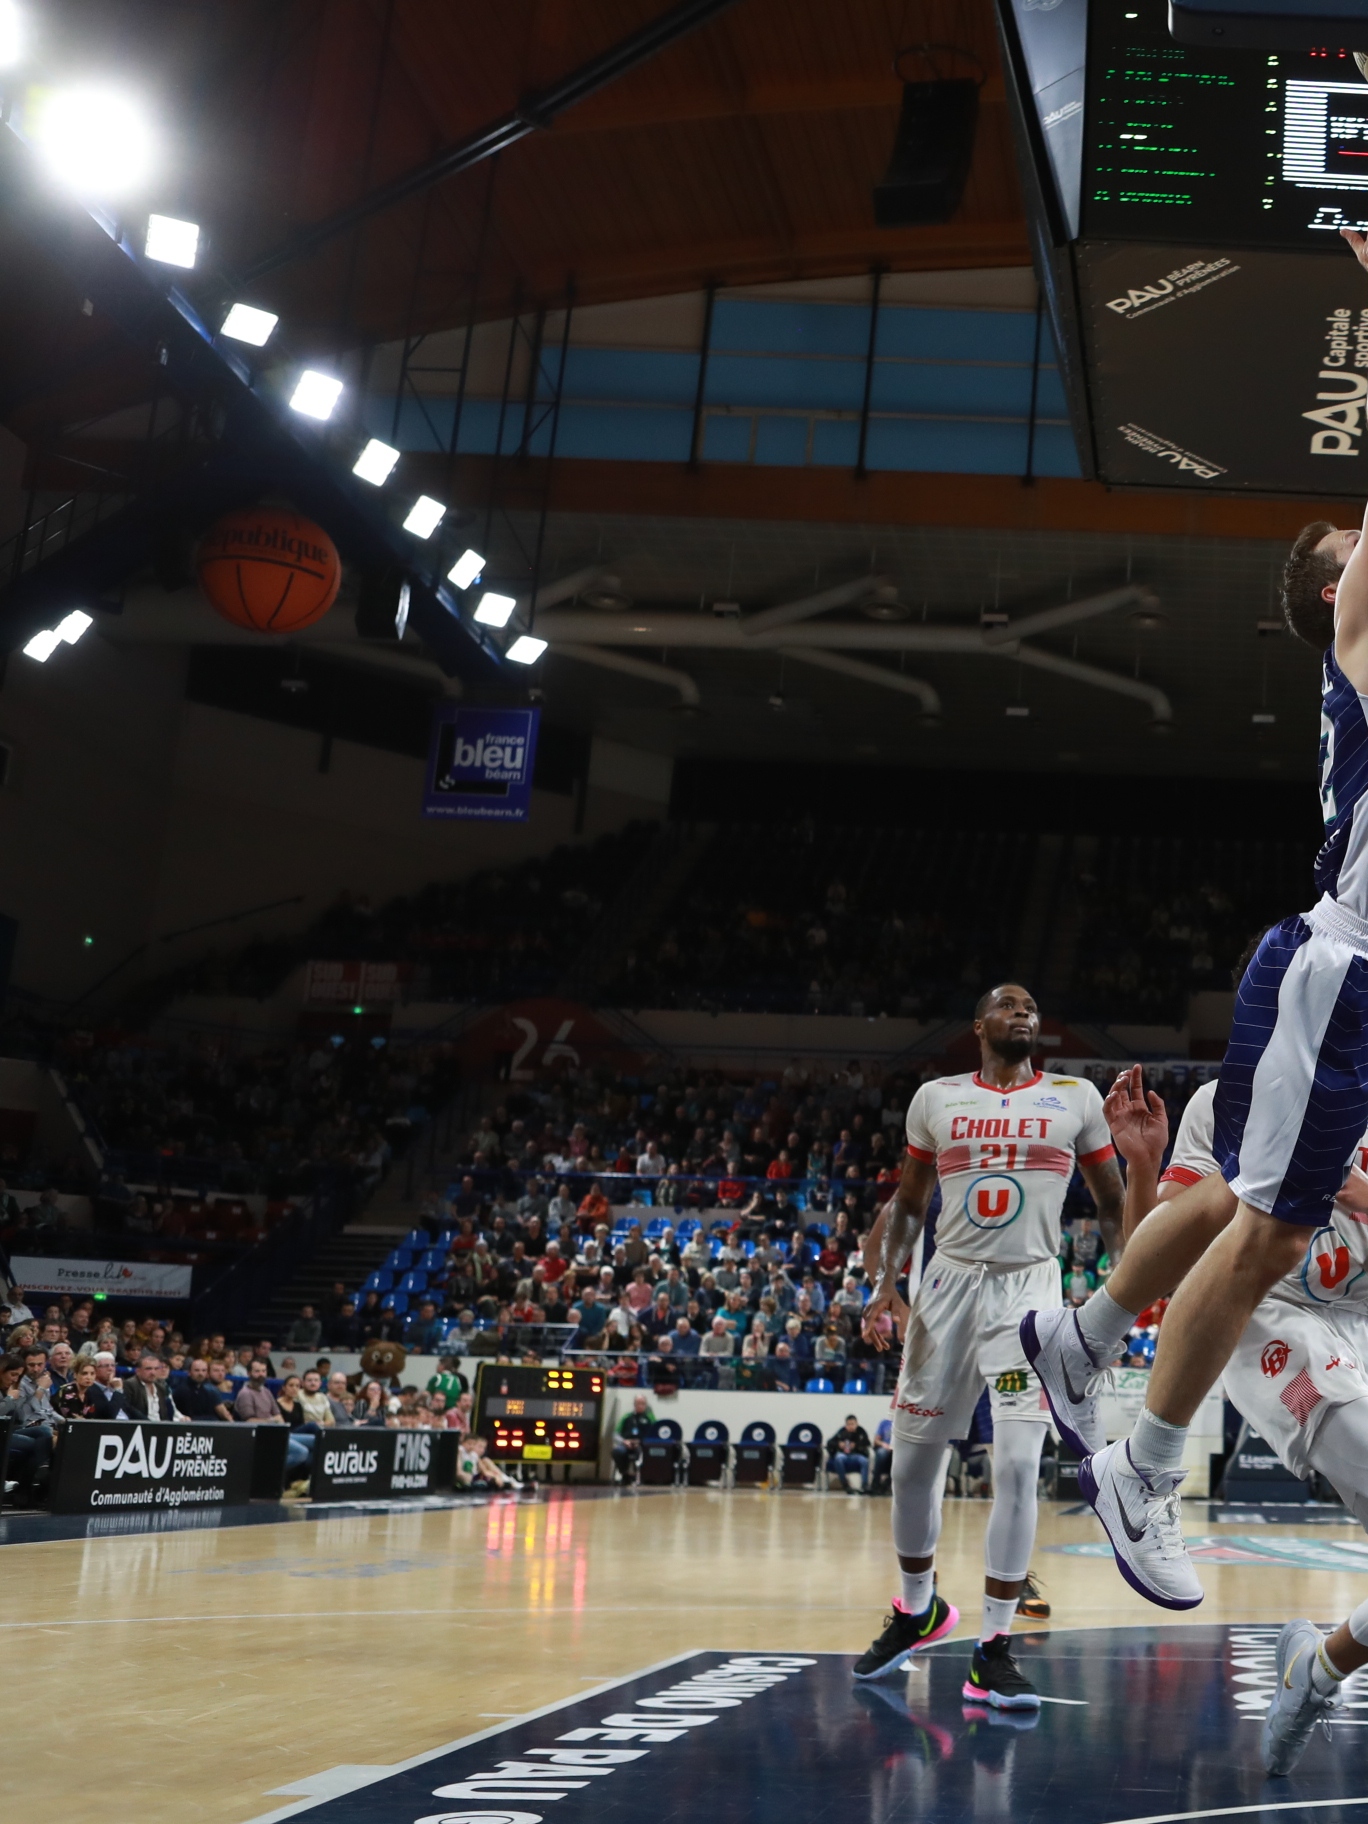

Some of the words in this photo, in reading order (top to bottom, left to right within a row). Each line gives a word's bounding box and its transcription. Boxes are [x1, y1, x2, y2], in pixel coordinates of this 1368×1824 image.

[1105, 279, 1174, 314] PAU
[1322, 308, 1354, 367] Capitale
[1301, 370, 1368, 456] PAU
[1157, 451, 1220, 479] PAU
[453, 737, 523, 770] bleu
[485, 733, 525, 746] france
[510, 1016, 580, 1081] 26
[951, 1116, 1052, 1140] CHOLET
[980, 1143, 1017, 1169] 21
[977, 1189, 1009, 1218] U
[57, 1267, 100, 1279] Presse
[1315, 1246, 1350, 1289] U
[94, 1425, 174, 1479] PAU
[175, 1432, 213, 1455] BÉARN
[172, 1455, 228, 1478] PYRÉNÉES
[393, 1433, 431, 1472] FMS
[90, 1486, 153, 1506] Communauté
[155, 1485, 224, 1506] d'Agglomération
[635, 1657, 818, 1710] CASINO
[554, 1713, 720, 1743] DE
[431, 1748, 652, 1801] PAU
